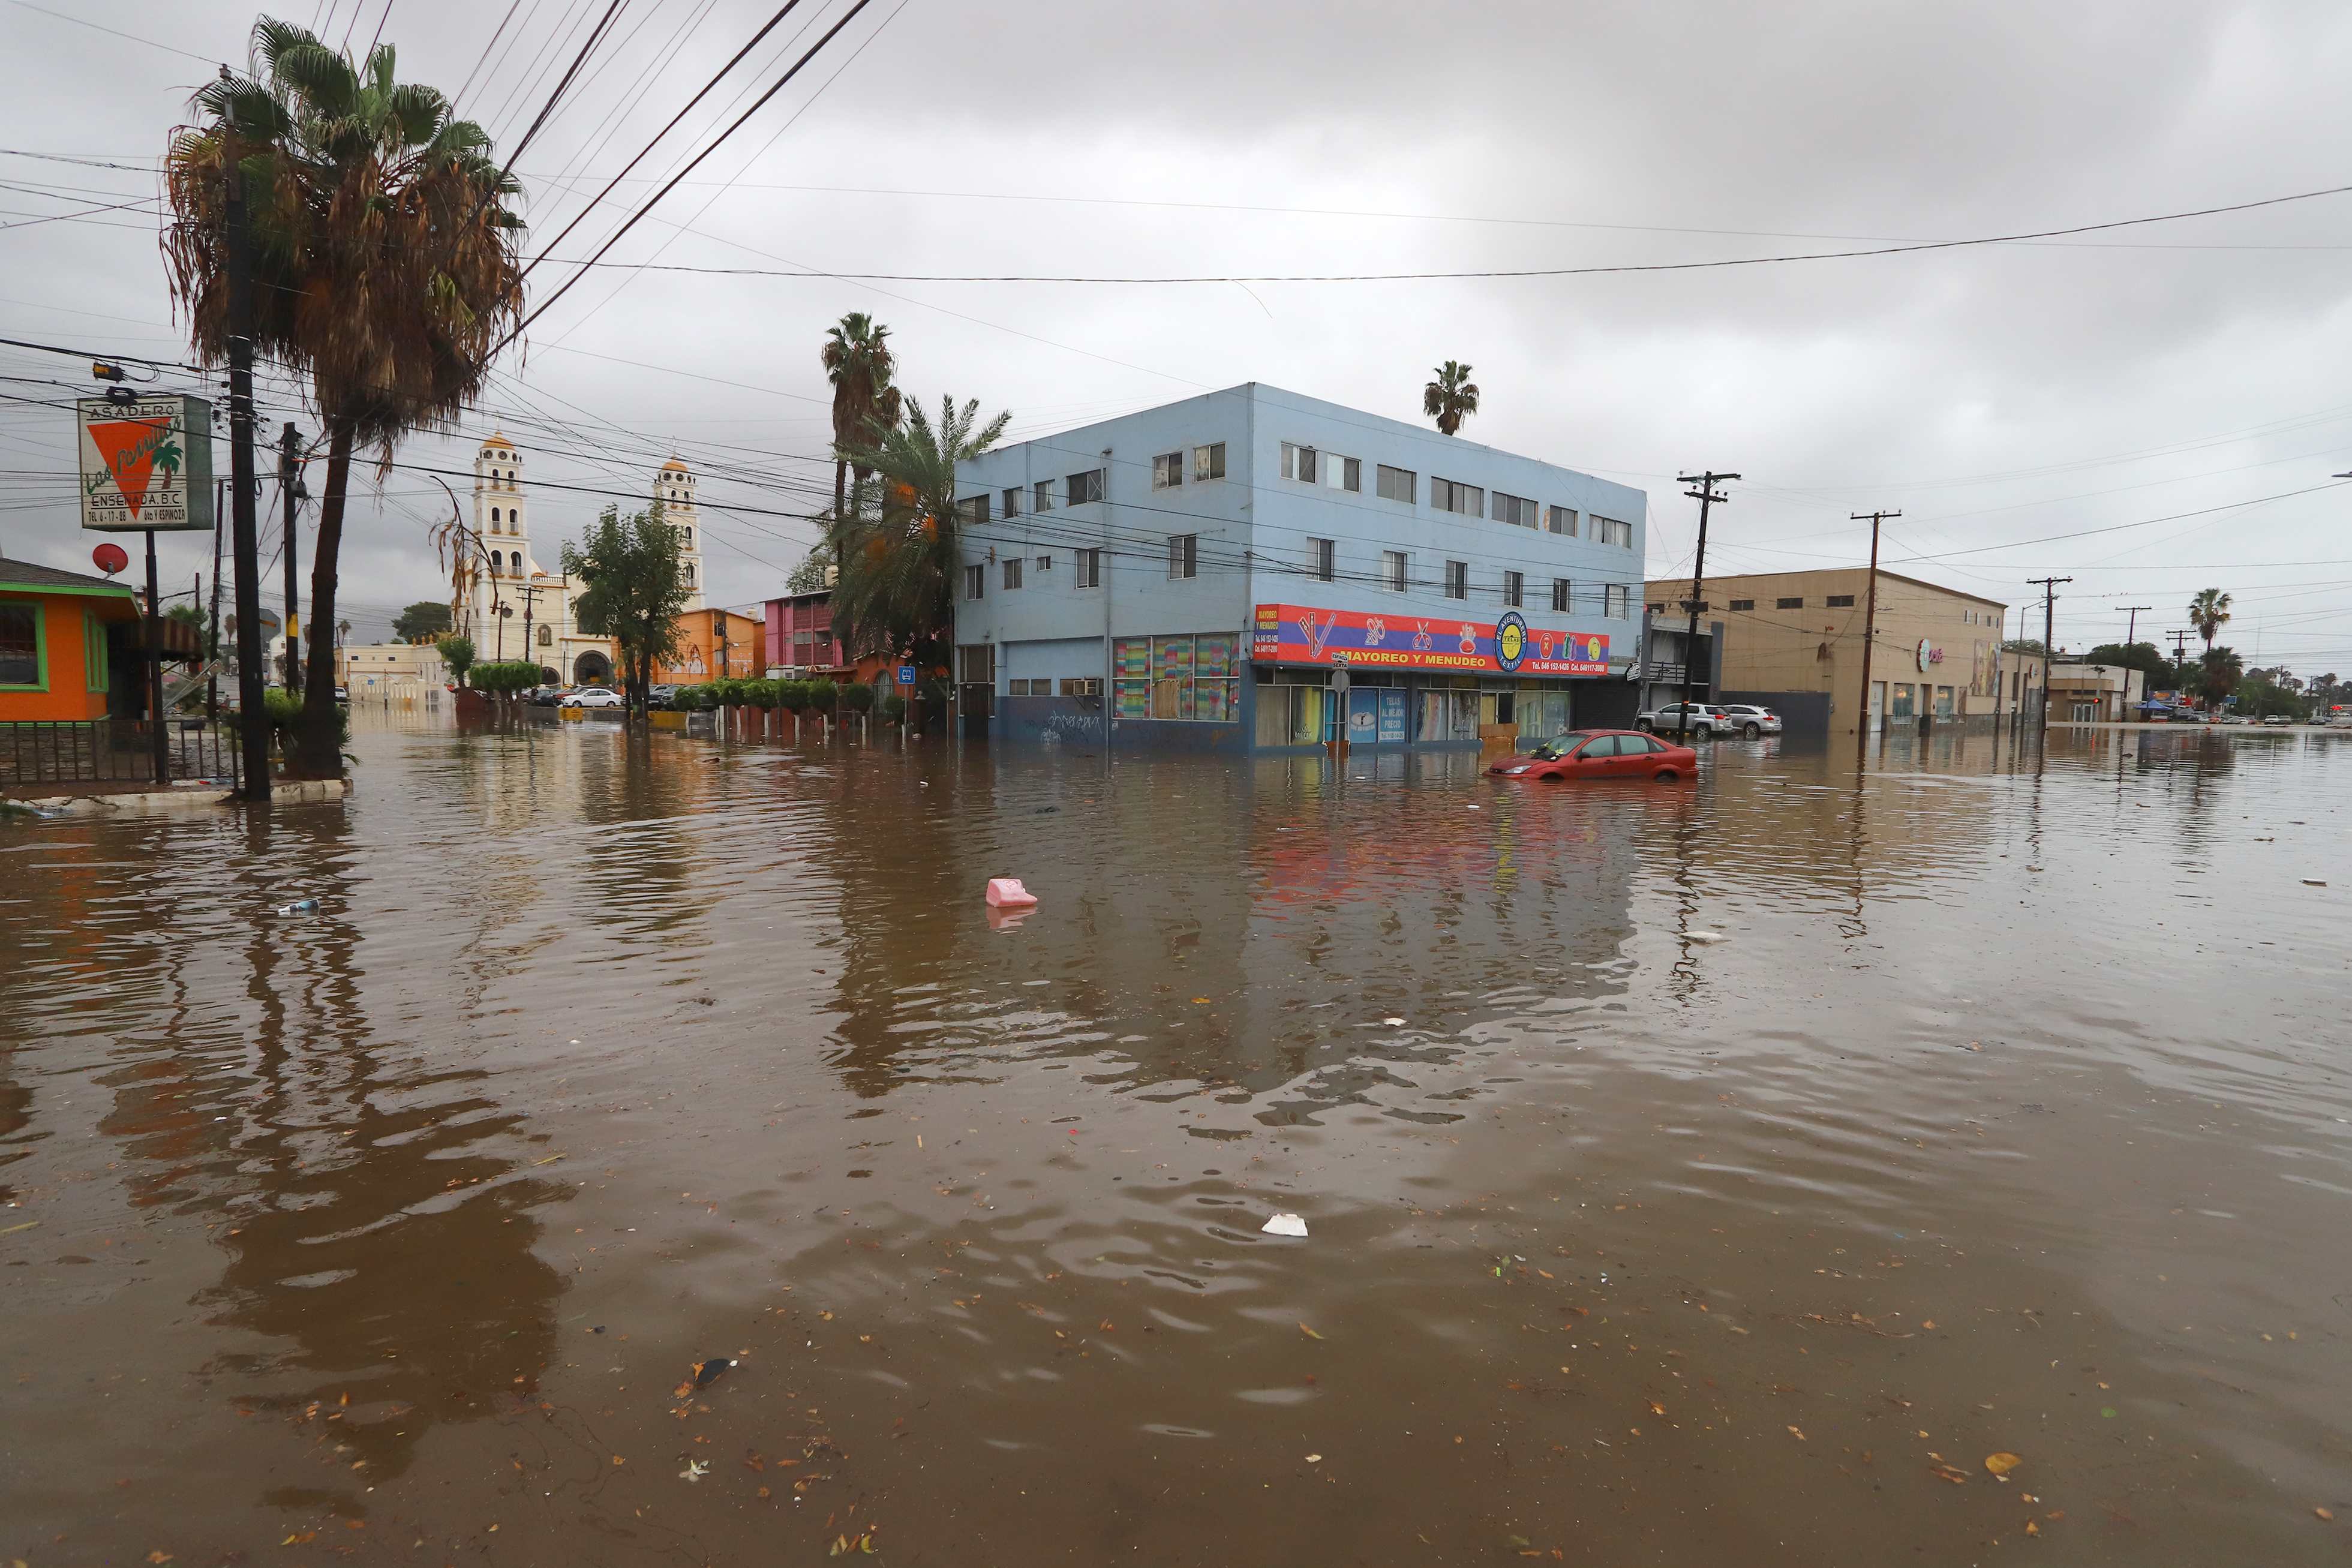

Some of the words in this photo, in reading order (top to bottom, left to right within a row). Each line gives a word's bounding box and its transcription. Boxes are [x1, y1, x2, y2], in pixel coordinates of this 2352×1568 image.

[91, 405, 175, 417] ASADERO
[161, 493, 182, 504] B.C.
[154, 510, 158, 519] Y
[159, 509, 185, 520] ESPINOZA
[1258, 611, 1277, 619] MAYOREO
[1256, 621, 1260, 630] Y
[1260, 621, 1279, 630] MENUDEO
[1497, 630, 1503, 641] EL
[1501, 615, 1527, 644] AVENTURERO
[1340, 651, 1409, 663] MAYOREO
[1413, 654, 1422, 663] Y
[1425, 655, 1486, 667] MENUDEO
[1500, 655, 1521, 669] TEXTIL
[1541, 662, 1549, 670] 646
[1550, 662, 1569, 671] 152-1426
[1384, 719, 1401, 729] PRECIO
